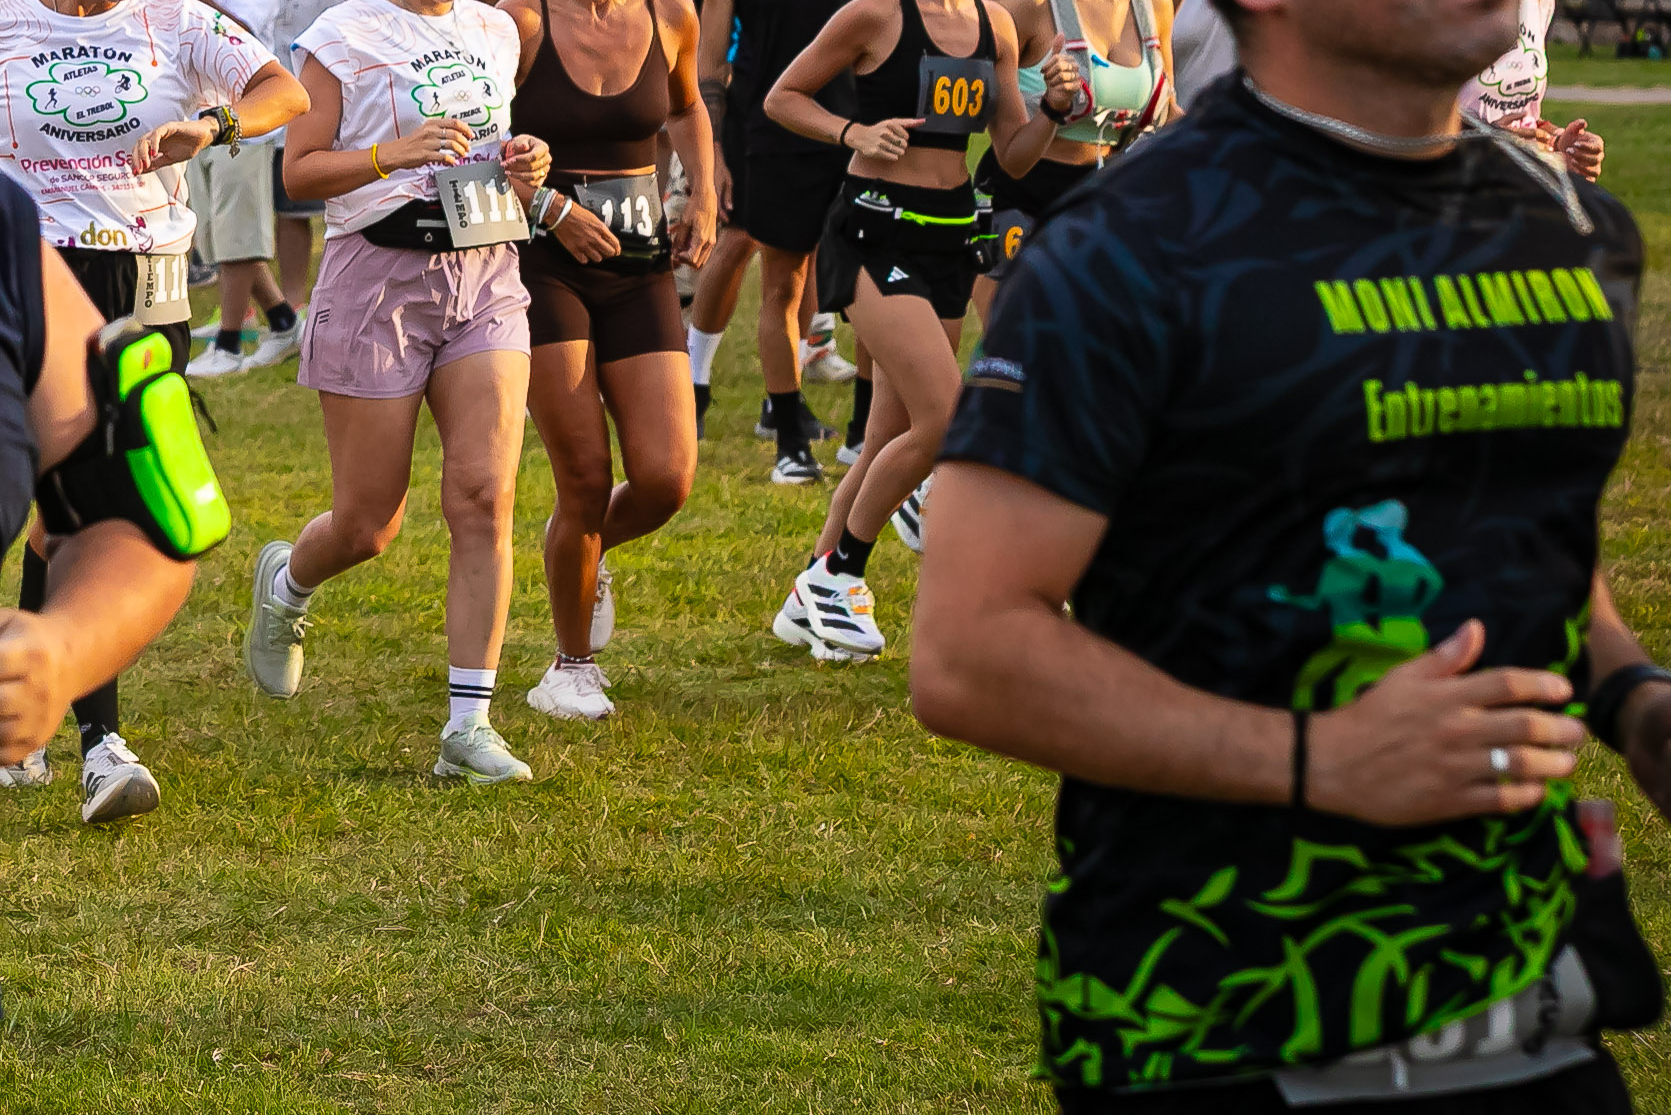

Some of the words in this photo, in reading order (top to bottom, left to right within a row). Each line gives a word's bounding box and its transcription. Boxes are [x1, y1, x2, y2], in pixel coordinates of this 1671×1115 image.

[31, 45, 132, 68] MARATÓN
[63, 66, 98, 82] ATLETAS
[933, 75, 985, 117] 603
[76, 111, 85, 120] EL
[86, 101, 114, 117] TREBOL
[39, 117, 141, 142] ANIVERSARIO
[20, 154, 112, 173] Prevención
[601, 195, 652, 237] 113
[80, 221, 127, 246] don
[1313, 275, 1437, 334] MONI
[1363, 369, 1624, 443] Entrenamientos
